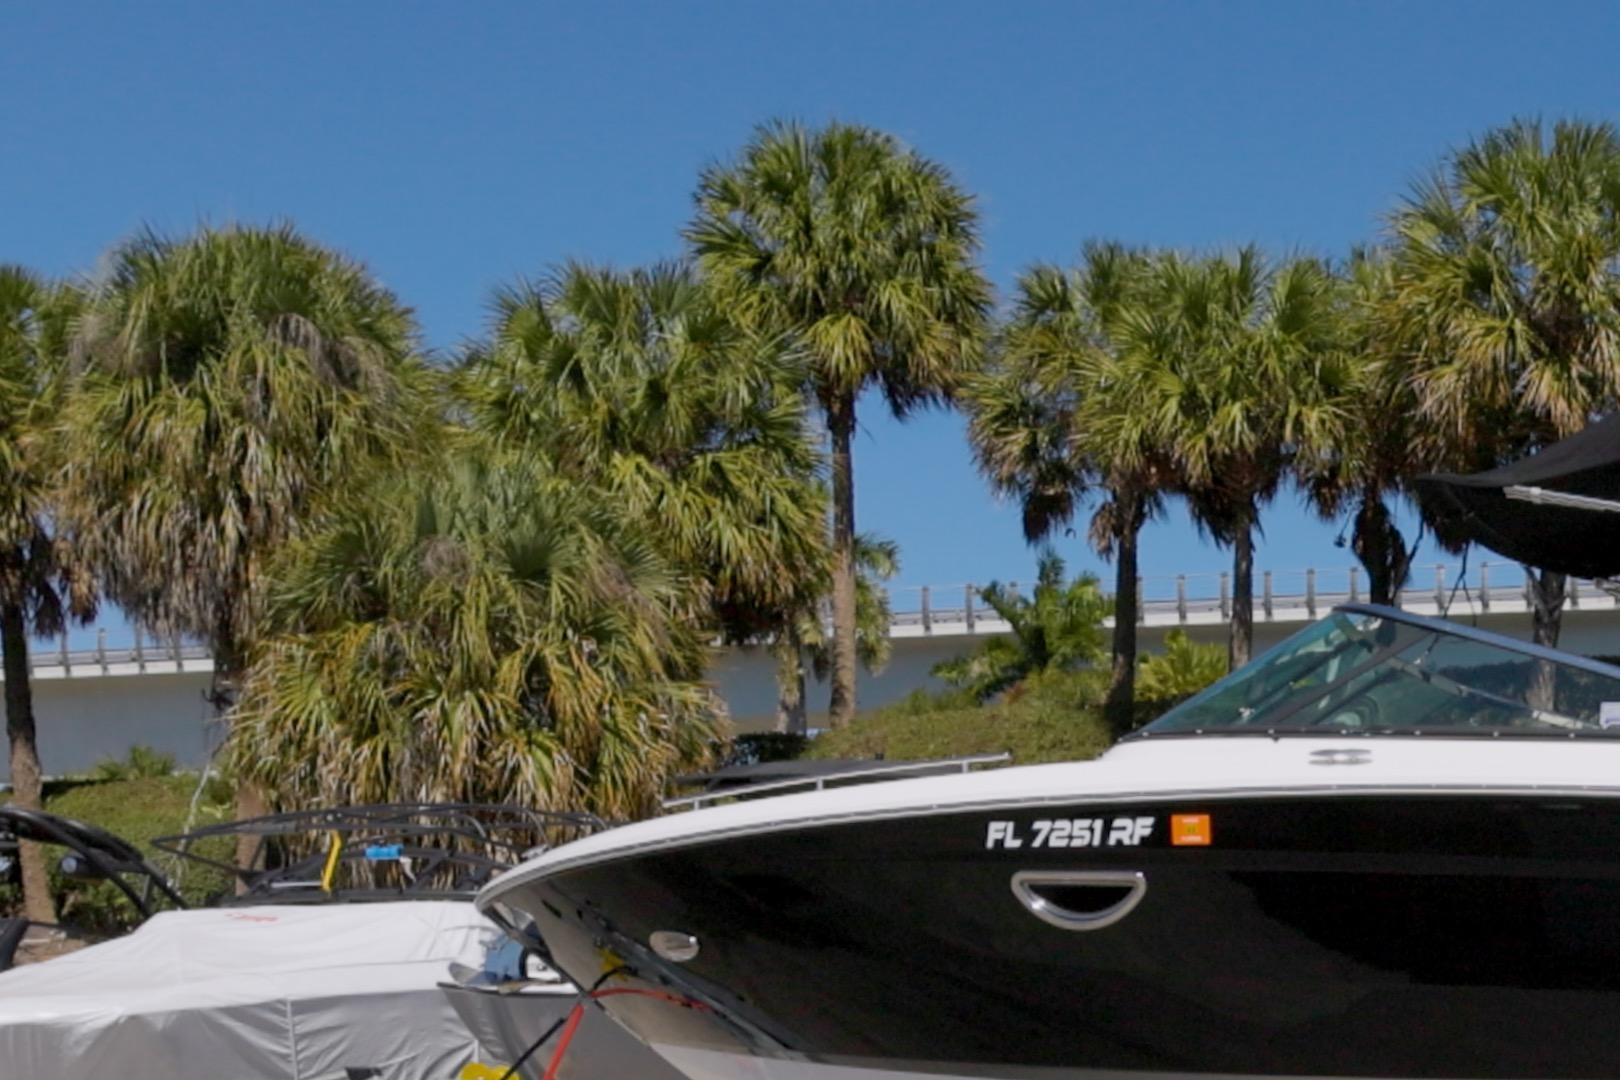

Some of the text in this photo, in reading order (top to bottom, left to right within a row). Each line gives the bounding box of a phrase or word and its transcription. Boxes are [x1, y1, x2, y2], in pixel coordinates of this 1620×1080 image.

[985, 820, 1023, 849] FL
[1031, 818, 1104, 848] 7251
[1107, 816, 1156, 846] RF
